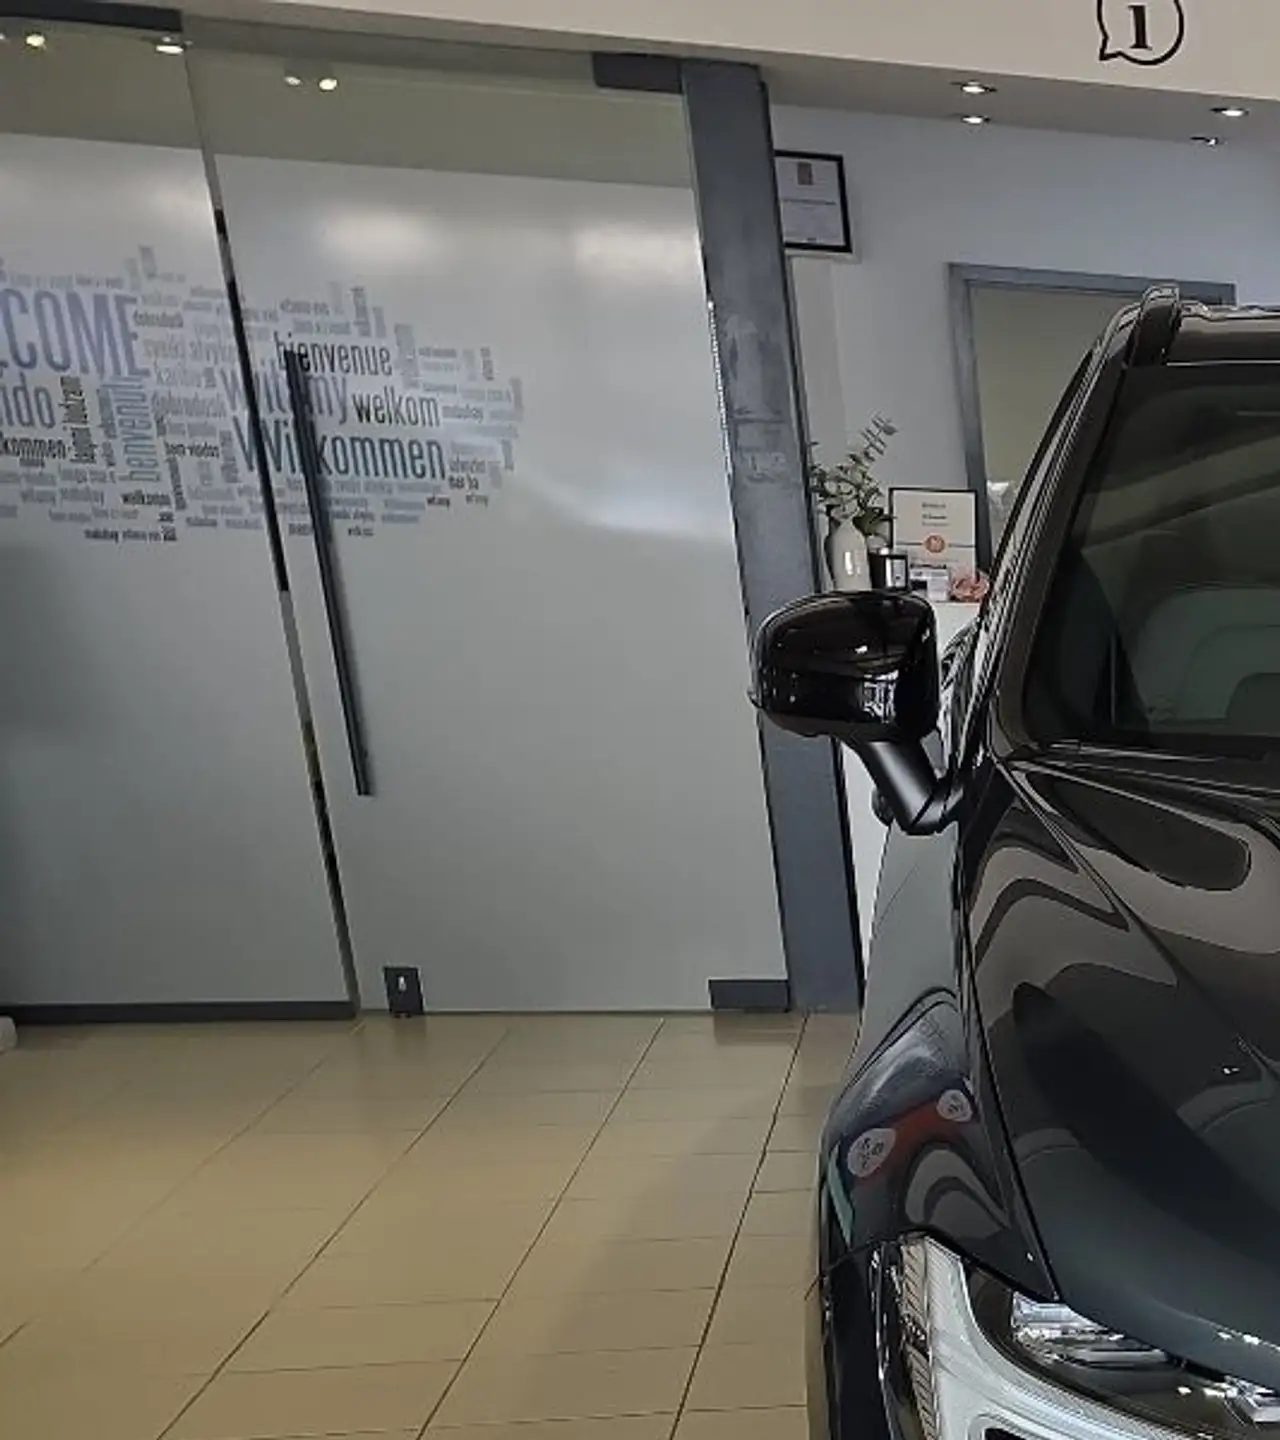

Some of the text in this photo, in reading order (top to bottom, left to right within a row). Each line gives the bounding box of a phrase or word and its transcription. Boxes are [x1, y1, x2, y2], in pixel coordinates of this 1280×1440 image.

[0, 288, 151, 377] COME
[353, 385, 440, 428] welkom
[232, 415, 446, 480] Wikommen
